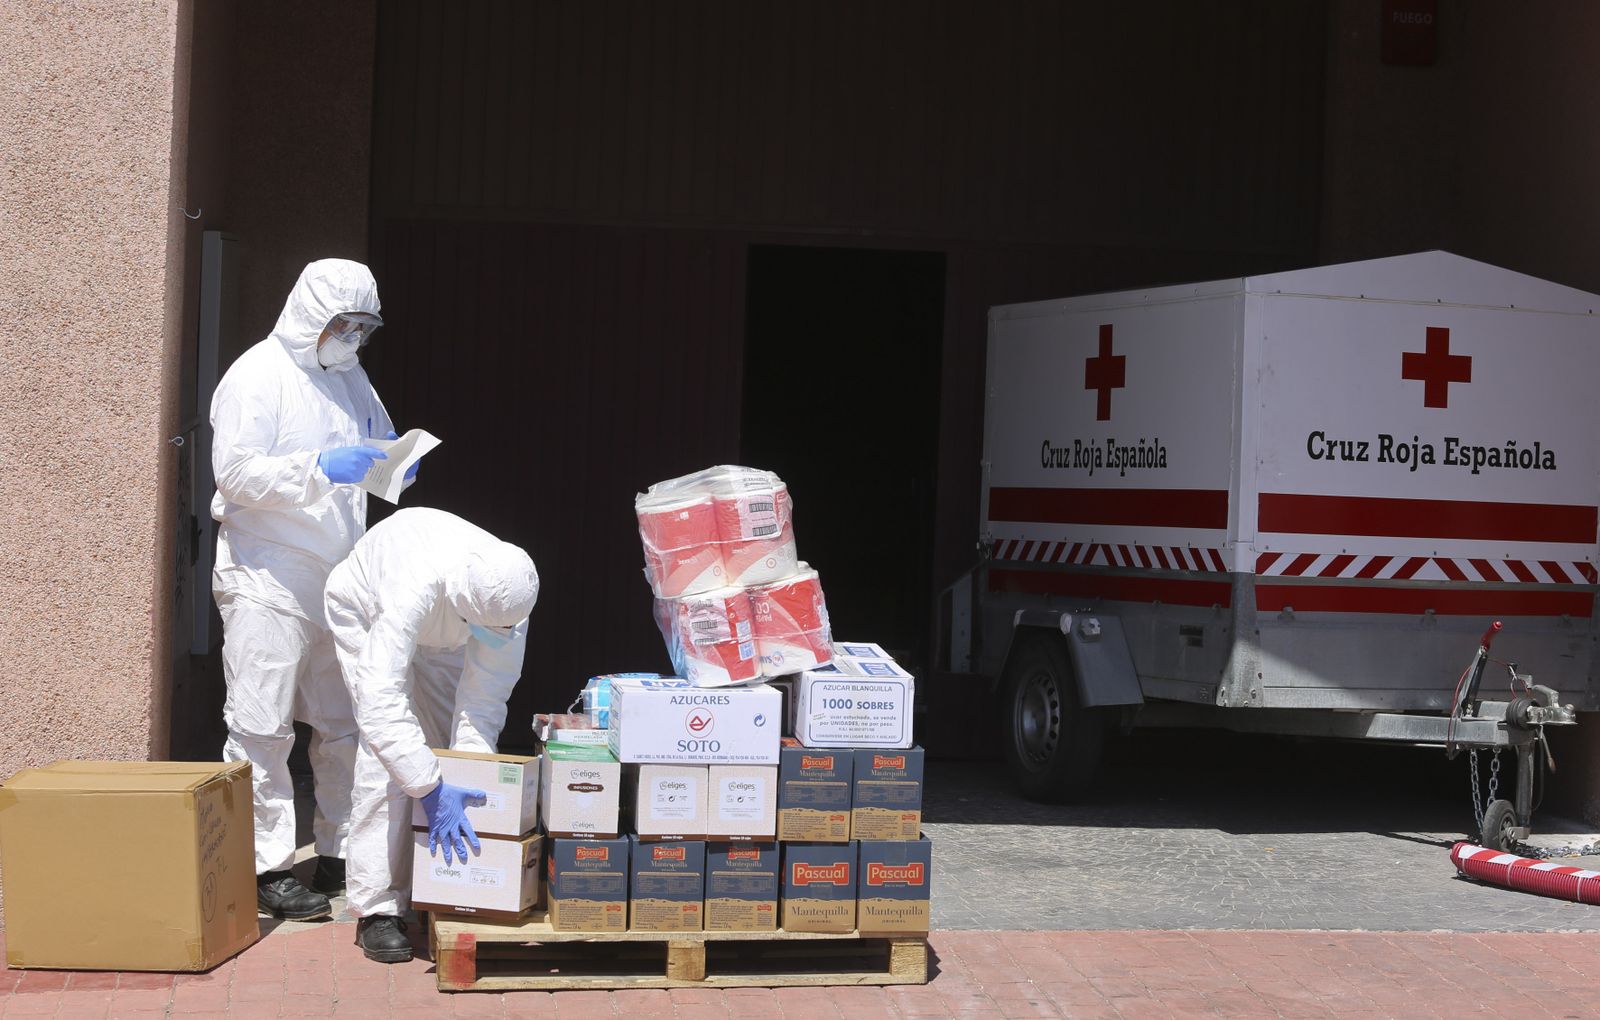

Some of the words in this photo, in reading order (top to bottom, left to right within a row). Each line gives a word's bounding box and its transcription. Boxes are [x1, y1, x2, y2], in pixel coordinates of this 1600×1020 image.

[1392, 11, 1433, 25] FUEGO
[1041, 439, 1070, 469] Cruz
[1073, 438, 1103, 477] Roja
[1105, 437, 1168, 477] Española
[1306, 430, 1370, 462] Cruz
[1377, 433, 1436, 472] Roja
[1443, 436, 1557, 475] Española
[822, 684, 851, 692] AZUCAR
[851, 685, 893, 693] BLANQUILLA
[669, 695, 731, 705] AZUCARES
[822, 698, 853, 709] 1000
[856, 701, 895, 710] SOBRES
[677, 740, 721, 753] SOTO
[801, 757, 830, 767] Pascual
[873, 757, 902, 767] Pascual
[576, 848, 605, 857] Pascual
[654, 848, 682, 857] Pascual
[796, 866, 845, 879] Pascual
[871, 866, 920, 879] Pascual
[791, 906, 849, 918] Mantequilla
[865, 906, 923, 918] Mantequilla
